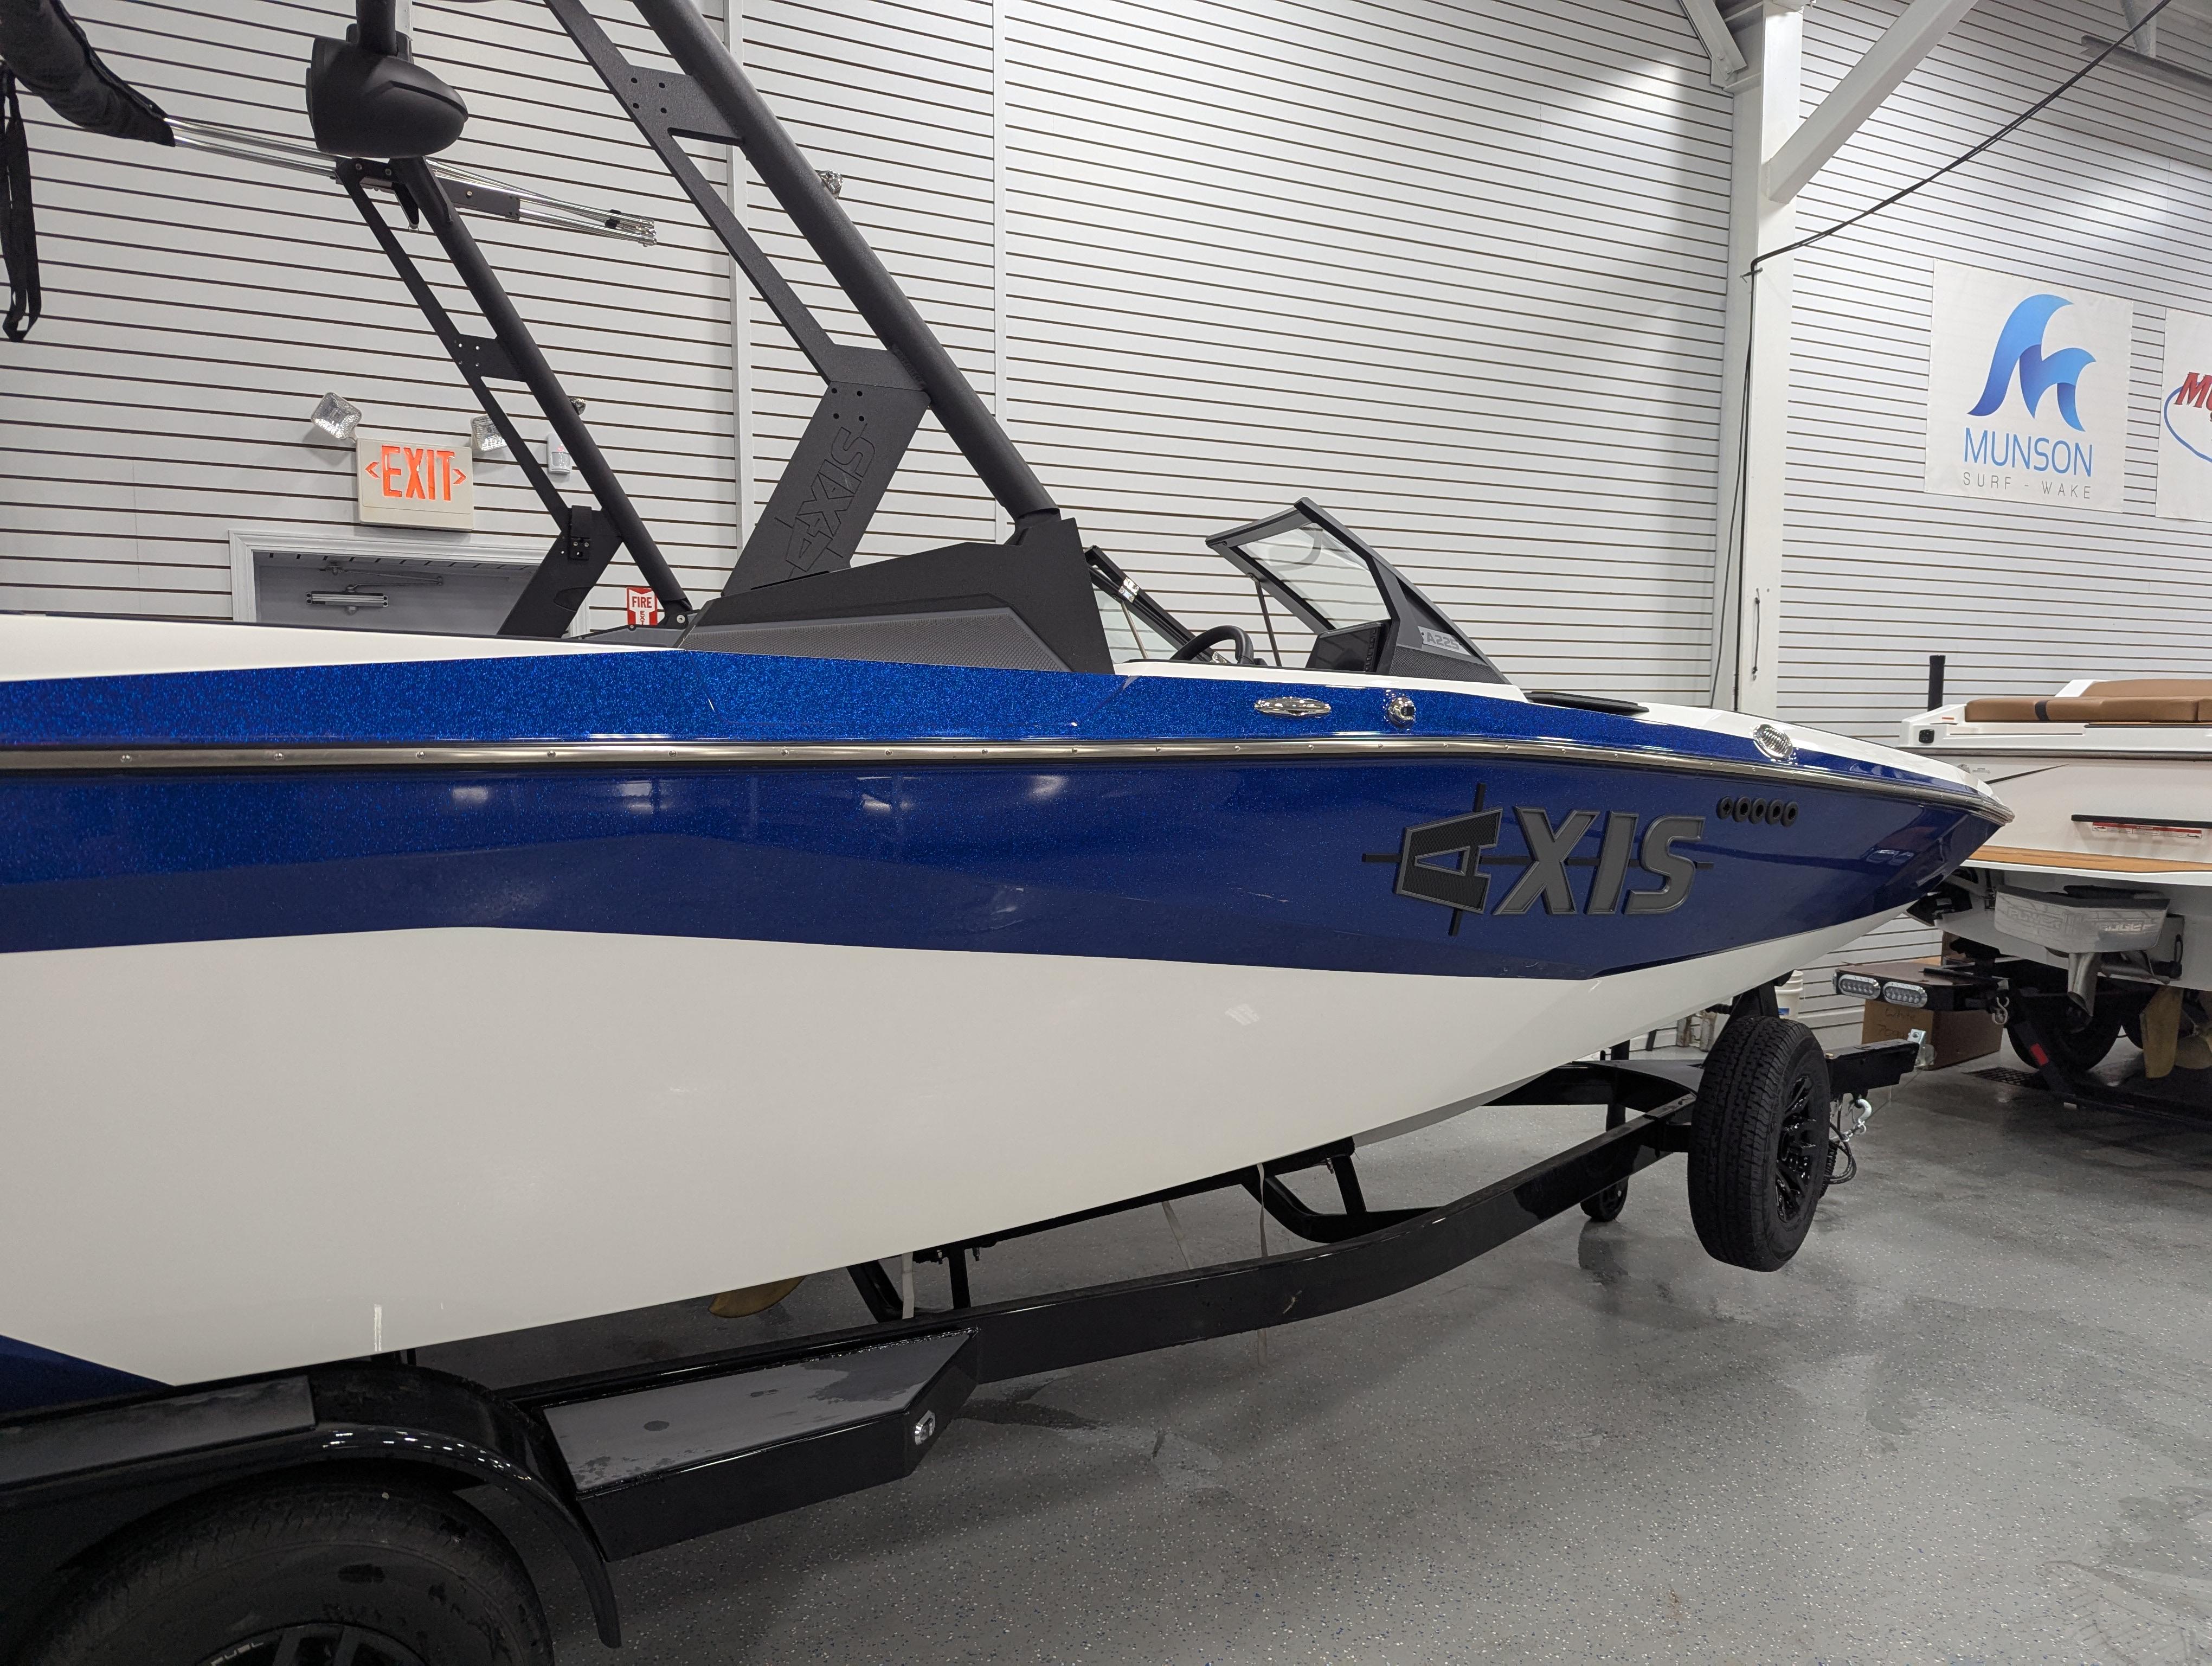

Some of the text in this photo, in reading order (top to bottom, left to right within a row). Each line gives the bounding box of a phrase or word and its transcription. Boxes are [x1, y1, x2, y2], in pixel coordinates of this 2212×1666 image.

[1964, 427, 2093, 477] MUNSON
[382, 445, 455, 501] EXIT
[1963, 471, 2011, 489] SURF
[2041, 480, 2091, 499] WAKE
[632, 596, 653, 608] FIRE
[1426, 632, 1459, 650] A225
[1394, 806, 1706, 917] AXIS
